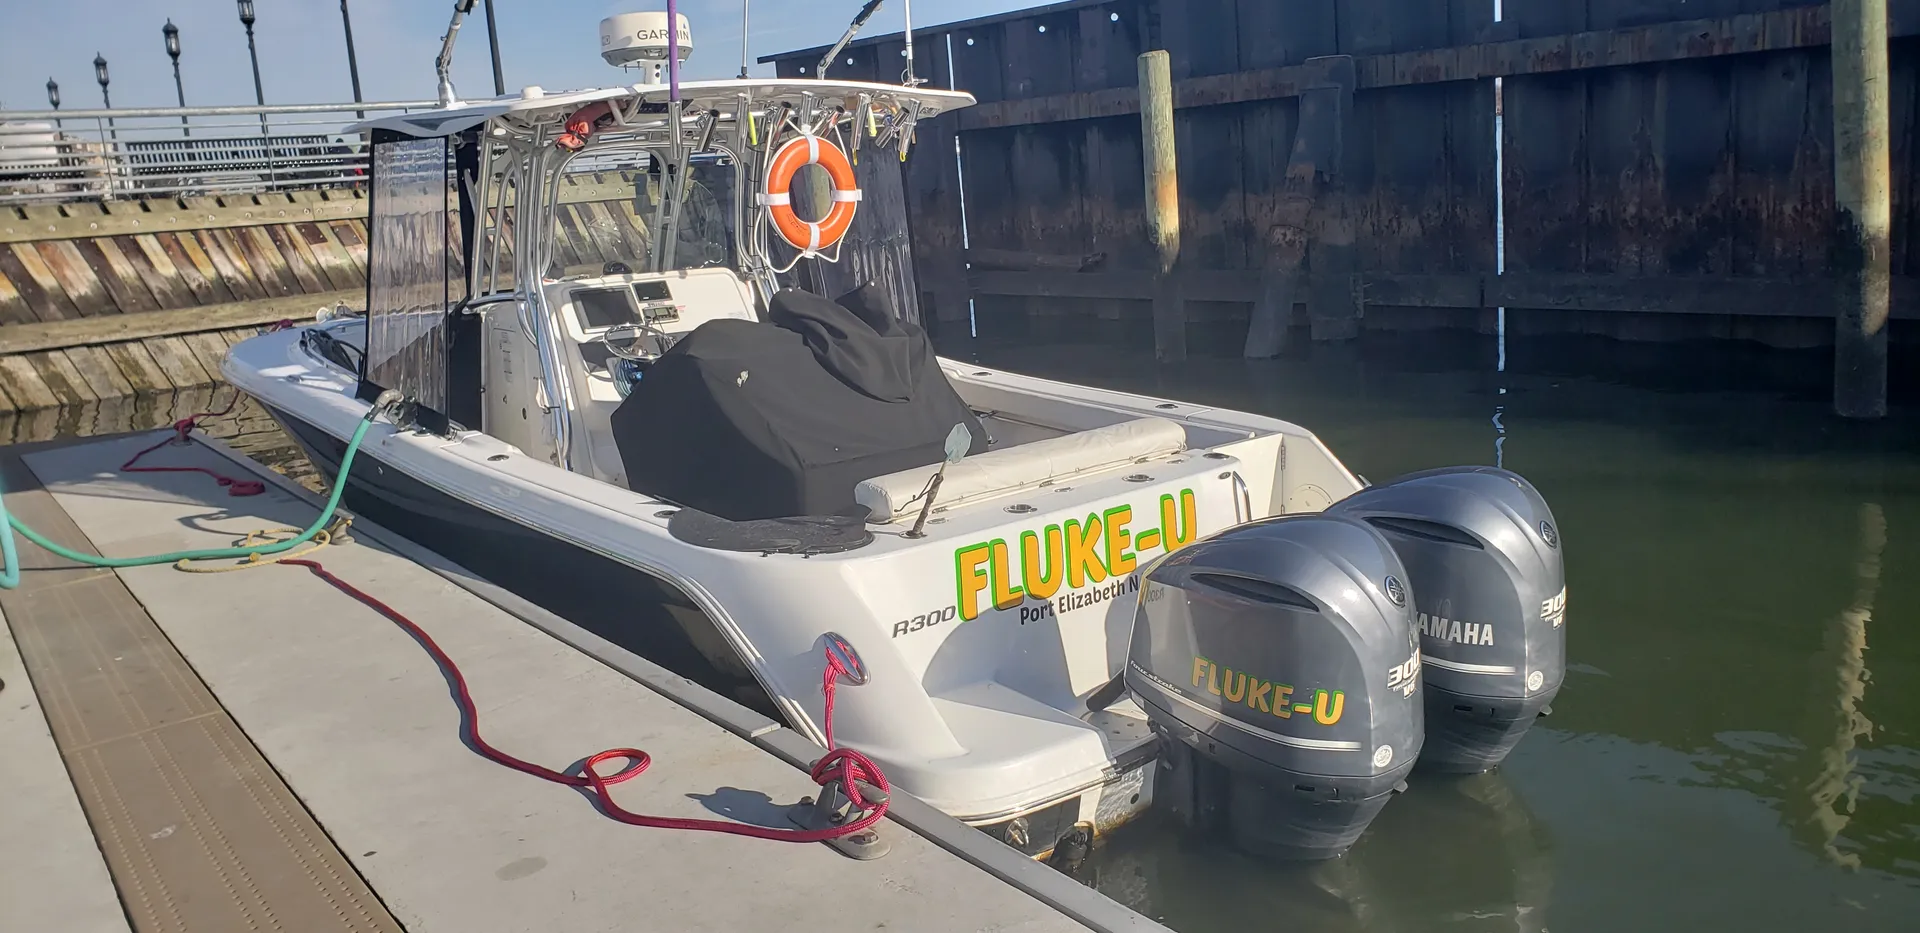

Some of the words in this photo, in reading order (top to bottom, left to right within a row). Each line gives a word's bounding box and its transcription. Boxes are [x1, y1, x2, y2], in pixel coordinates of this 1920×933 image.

[637, 30, 689, 40] GARIN
[955, 488, 1198, 622] FLUKE-U
[892, 605, 956, 638] R300
[1020, 600, 1054, 625] Port
[1058, 580, 1125, 614] Elizabeth
[1416, 612, 1494, 646] AMAHA
[1387, 647, 1420, 689] 300
[1191, 656, 1345, 726] FLUKE-U
